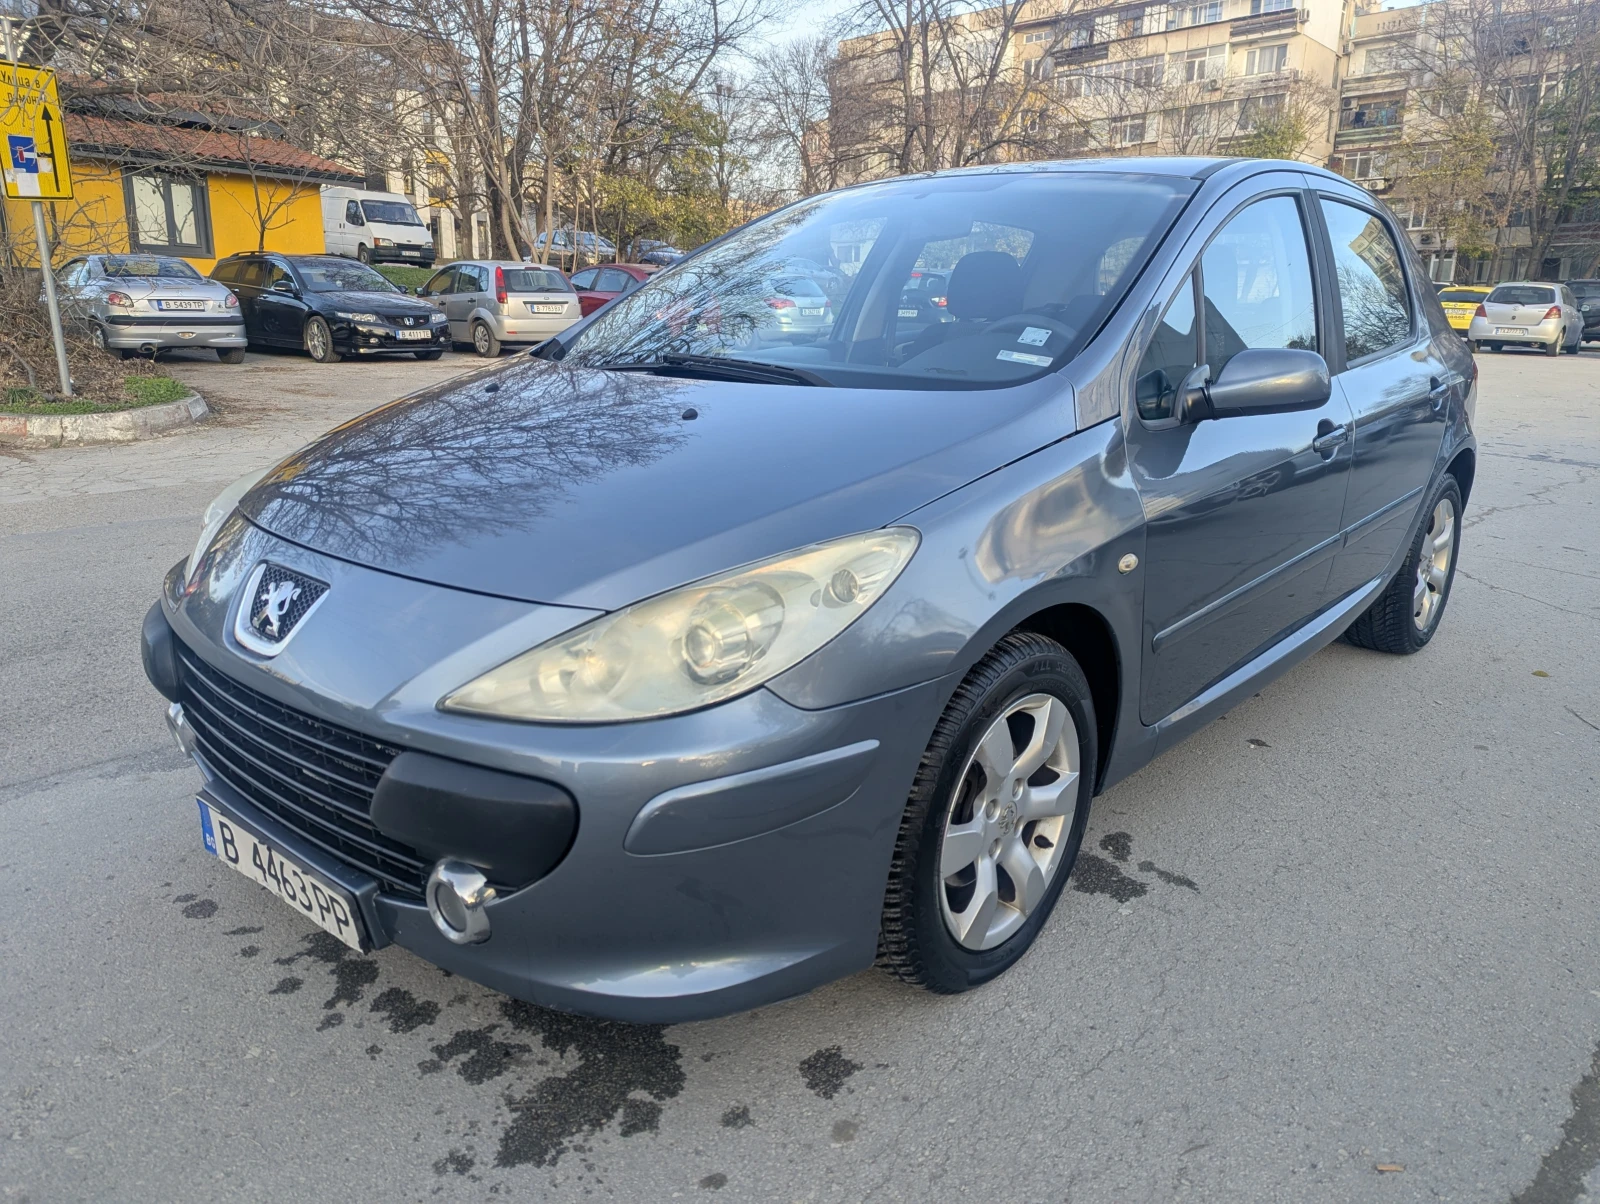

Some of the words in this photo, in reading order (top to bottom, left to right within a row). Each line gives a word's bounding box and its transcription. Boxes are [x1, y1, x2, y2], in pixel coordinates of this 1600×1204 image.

[1032, 660, 1051, 673] ALL
[206, 832, 216, 850] BG
[218, 819, 240, 865] B
